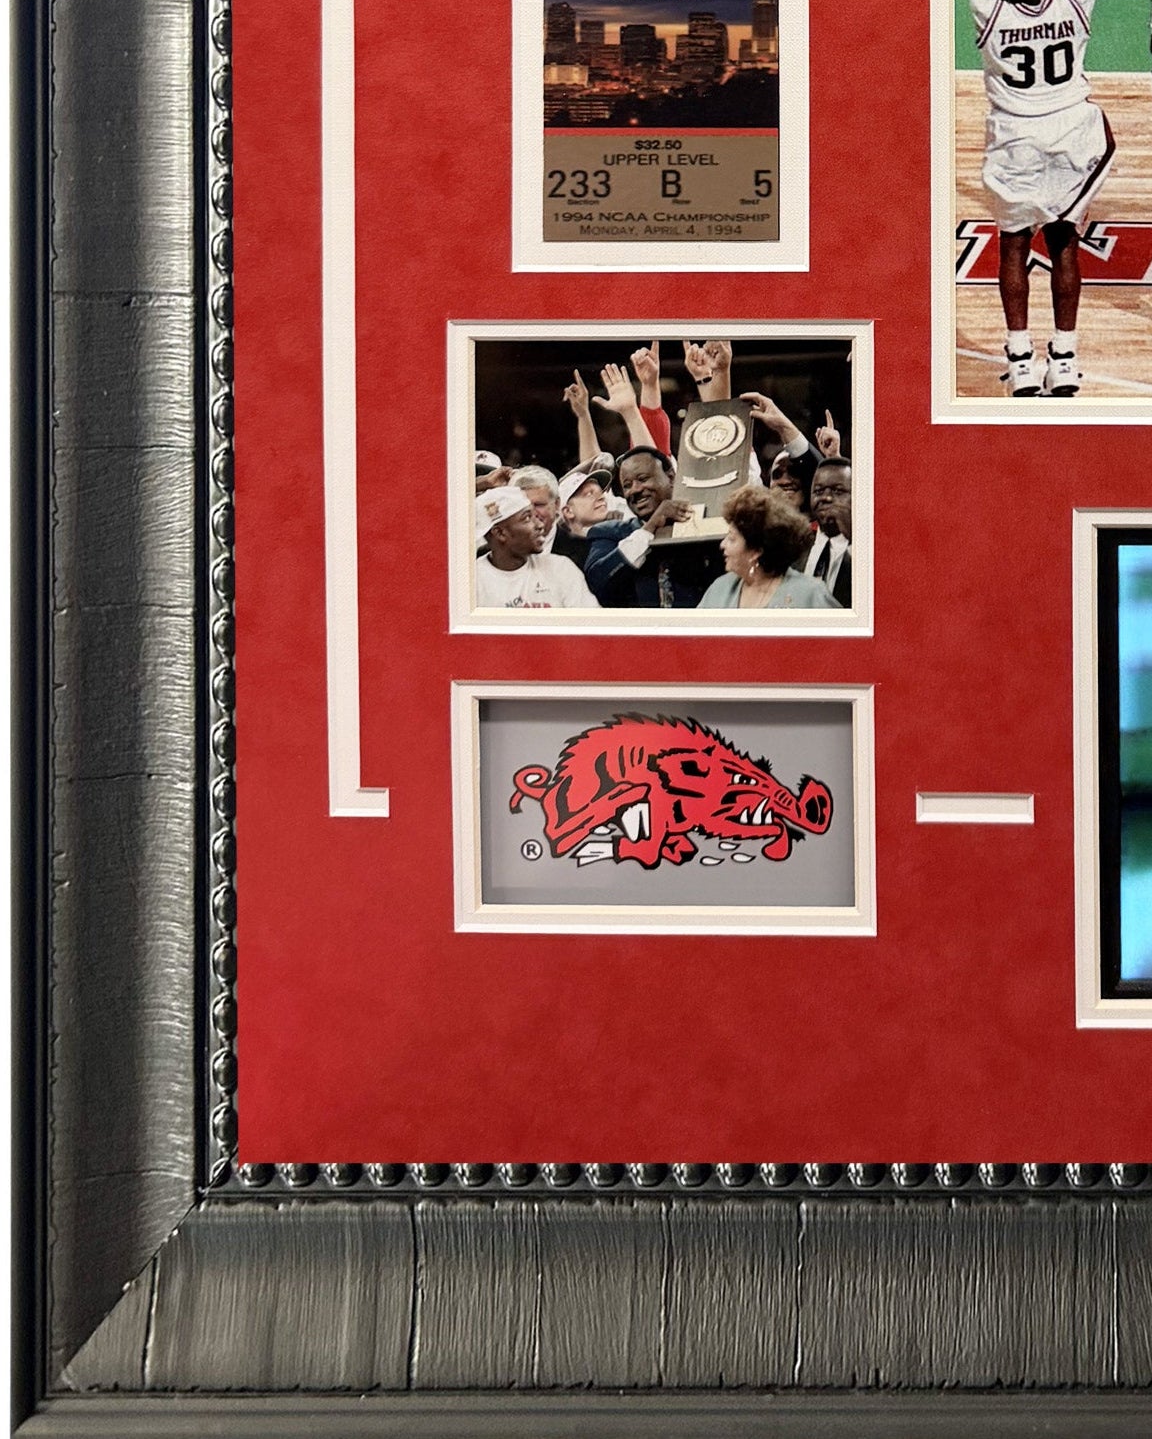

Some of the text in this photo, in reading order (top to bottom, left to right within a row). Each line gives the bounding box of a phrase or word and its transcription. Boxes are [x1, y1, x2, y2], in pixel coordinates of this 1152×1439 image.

[999, 19, 1076, 46] THURMAN
[1000, 40, 1075, 90] 30
[635, 140, 681, 150] $32.50
[603, 154, 719, 166] UPPER LEVEL
[548, 170, 772, 198] 233 B 5
[554, 212, 770, 222] 1994 NCAA CHAMPIONSHIP
[707, 225, 742, 235] 1994
